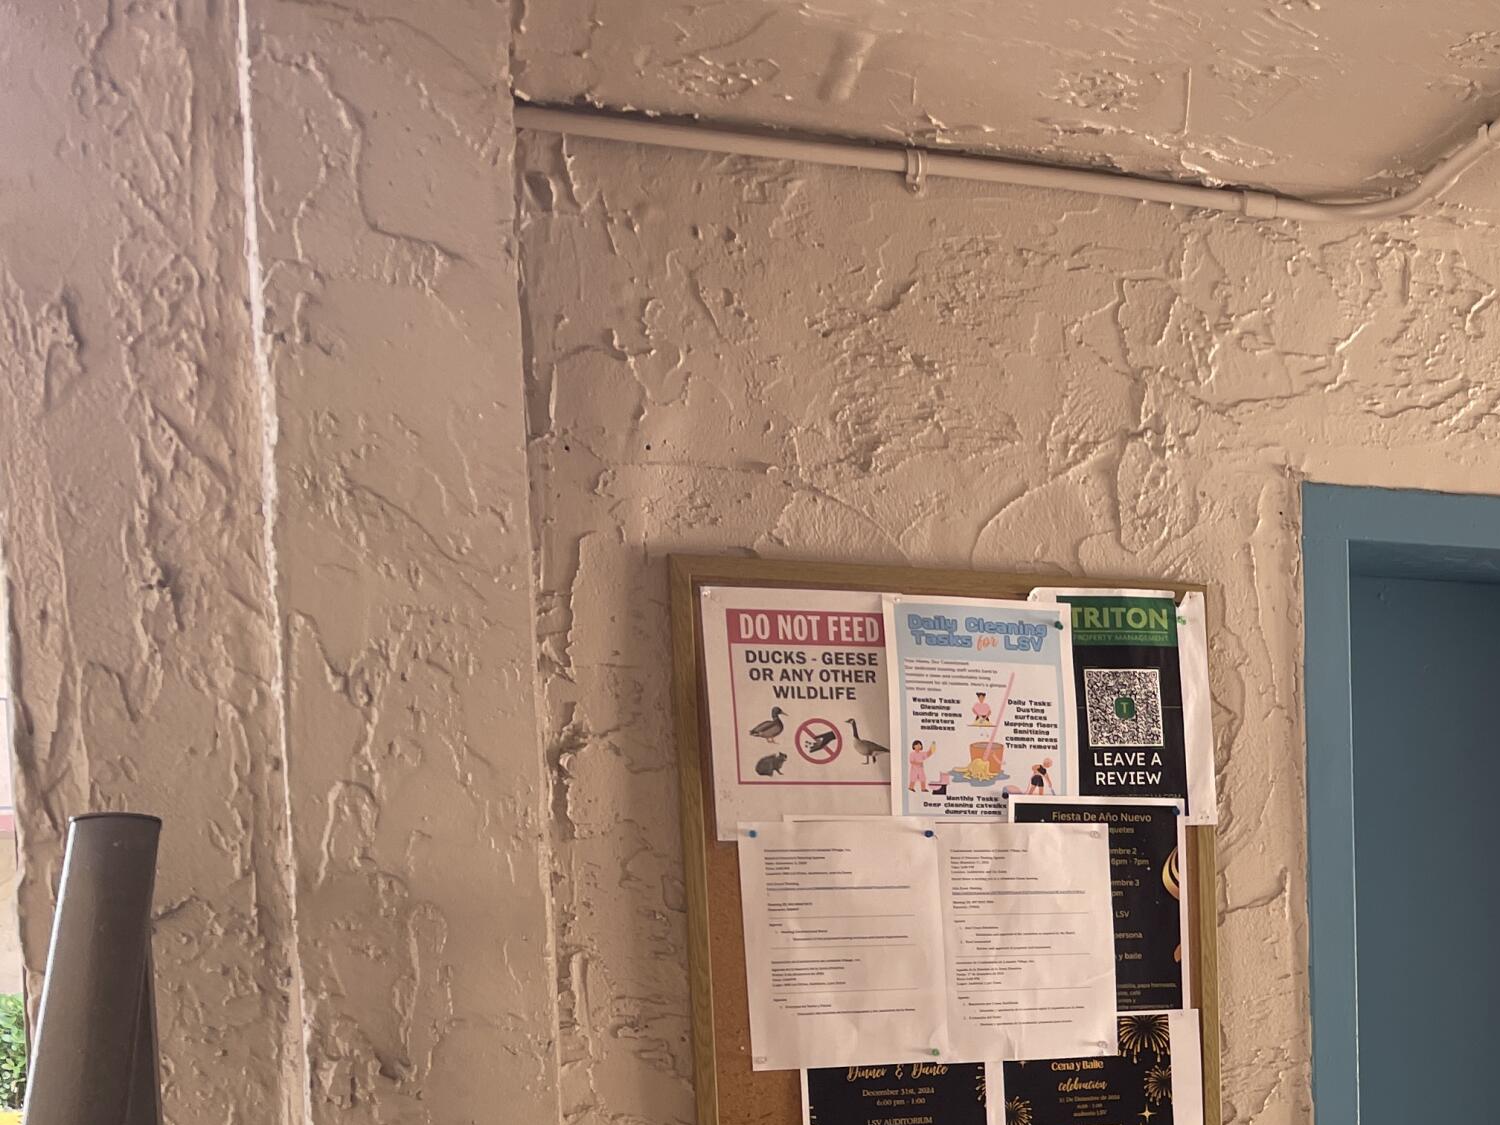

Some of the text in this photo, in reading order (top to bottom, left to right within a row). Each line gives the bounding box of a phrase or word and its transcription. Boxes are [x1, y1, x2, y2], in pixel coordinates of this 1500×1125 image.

[908, 614, 1047, 637] Daily Cleaning
[1071, 608, 1168, 630] TRITON
[739, 613, 879, 642] DO NOT FEED
[910, 630, 1044, 652] Tasks for LSV
[1116, 634, 1169, 642] MANAGEMENT
[745, 650, 806, 664] DUCKS
[822, 653, 878, 666] GEESE
[749, 668, 876, 683] OR ANY OTHER
[773, 686, 856, 700] WILDLIFE
[1013, 728, 1050, 736] Sanitizing
[1094, 752, 1162, 766] LEAVE A
[1096, 772, 1162, 785] REVIEW
[1052, 811, 1152, 822] Fiesta De Año Nuevo
[1134, 858, 1149, 866] 7pm
[847, 1065, 887, 1081] Dinner
[911, 1063, 948, 1078] Dance
[1051, 1060, 1104, 1072] Cena y Baile
[884, 1117, 933, 1125] AUDITORIUM
